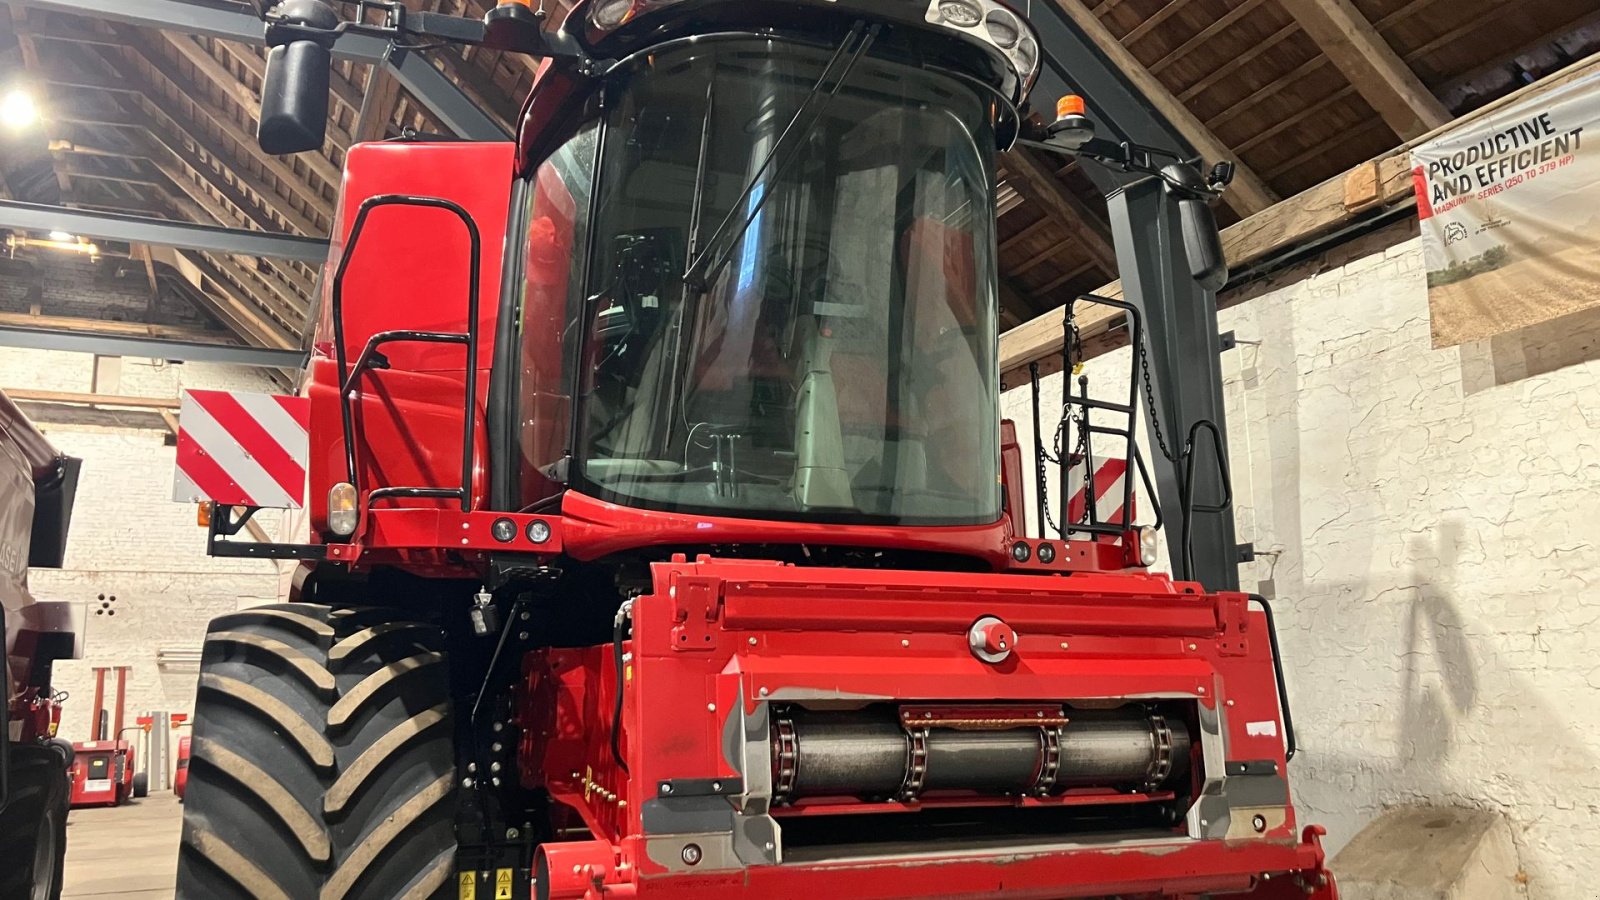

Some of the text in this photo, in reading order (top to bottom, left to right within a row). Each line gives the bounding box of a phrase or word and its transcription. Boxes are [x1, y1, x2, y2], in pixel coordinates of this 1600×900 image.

[1429, 112, 1556, 181] PRODUCTIVE
[1433, 127, 1583, 205] AND EFFICIENT
[1477, 185, 1504, 200] SERIES
[1505, 174, 1523, 190] (250
[1525, 170, 1536, 180] TO
[1539, 164, 1556, 175] 379
[1559, 154, 1574, 168] HP)
